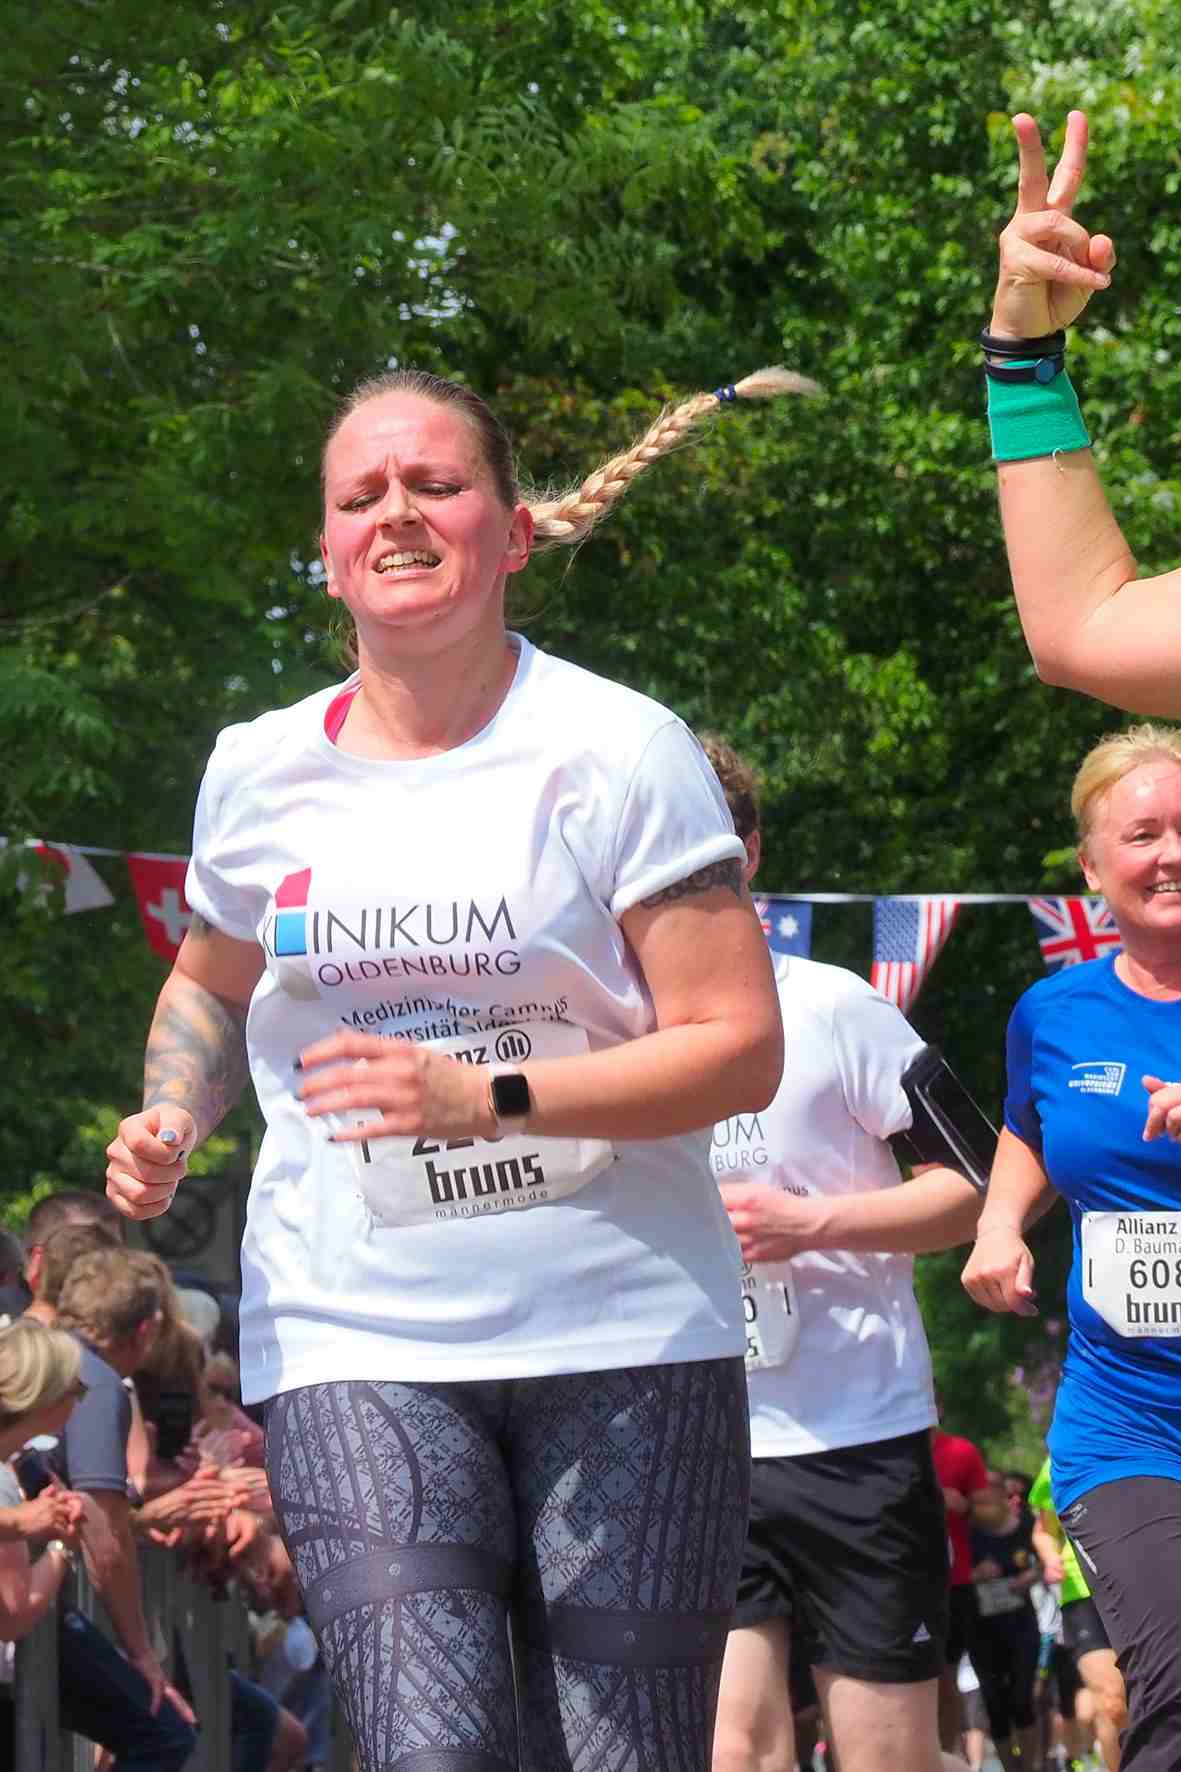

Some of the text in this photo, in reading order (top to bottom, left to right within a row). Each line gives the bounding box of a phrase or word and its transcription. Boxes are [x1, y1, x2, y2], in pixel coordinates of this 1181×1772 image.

[318, 950, 522, 987] OLDENBURG
[425, 1153, 545, 1204] bruns
[1116, 1219, 1178, 1235] Allianz
[1115, 1239, 1131, 1254] D.
